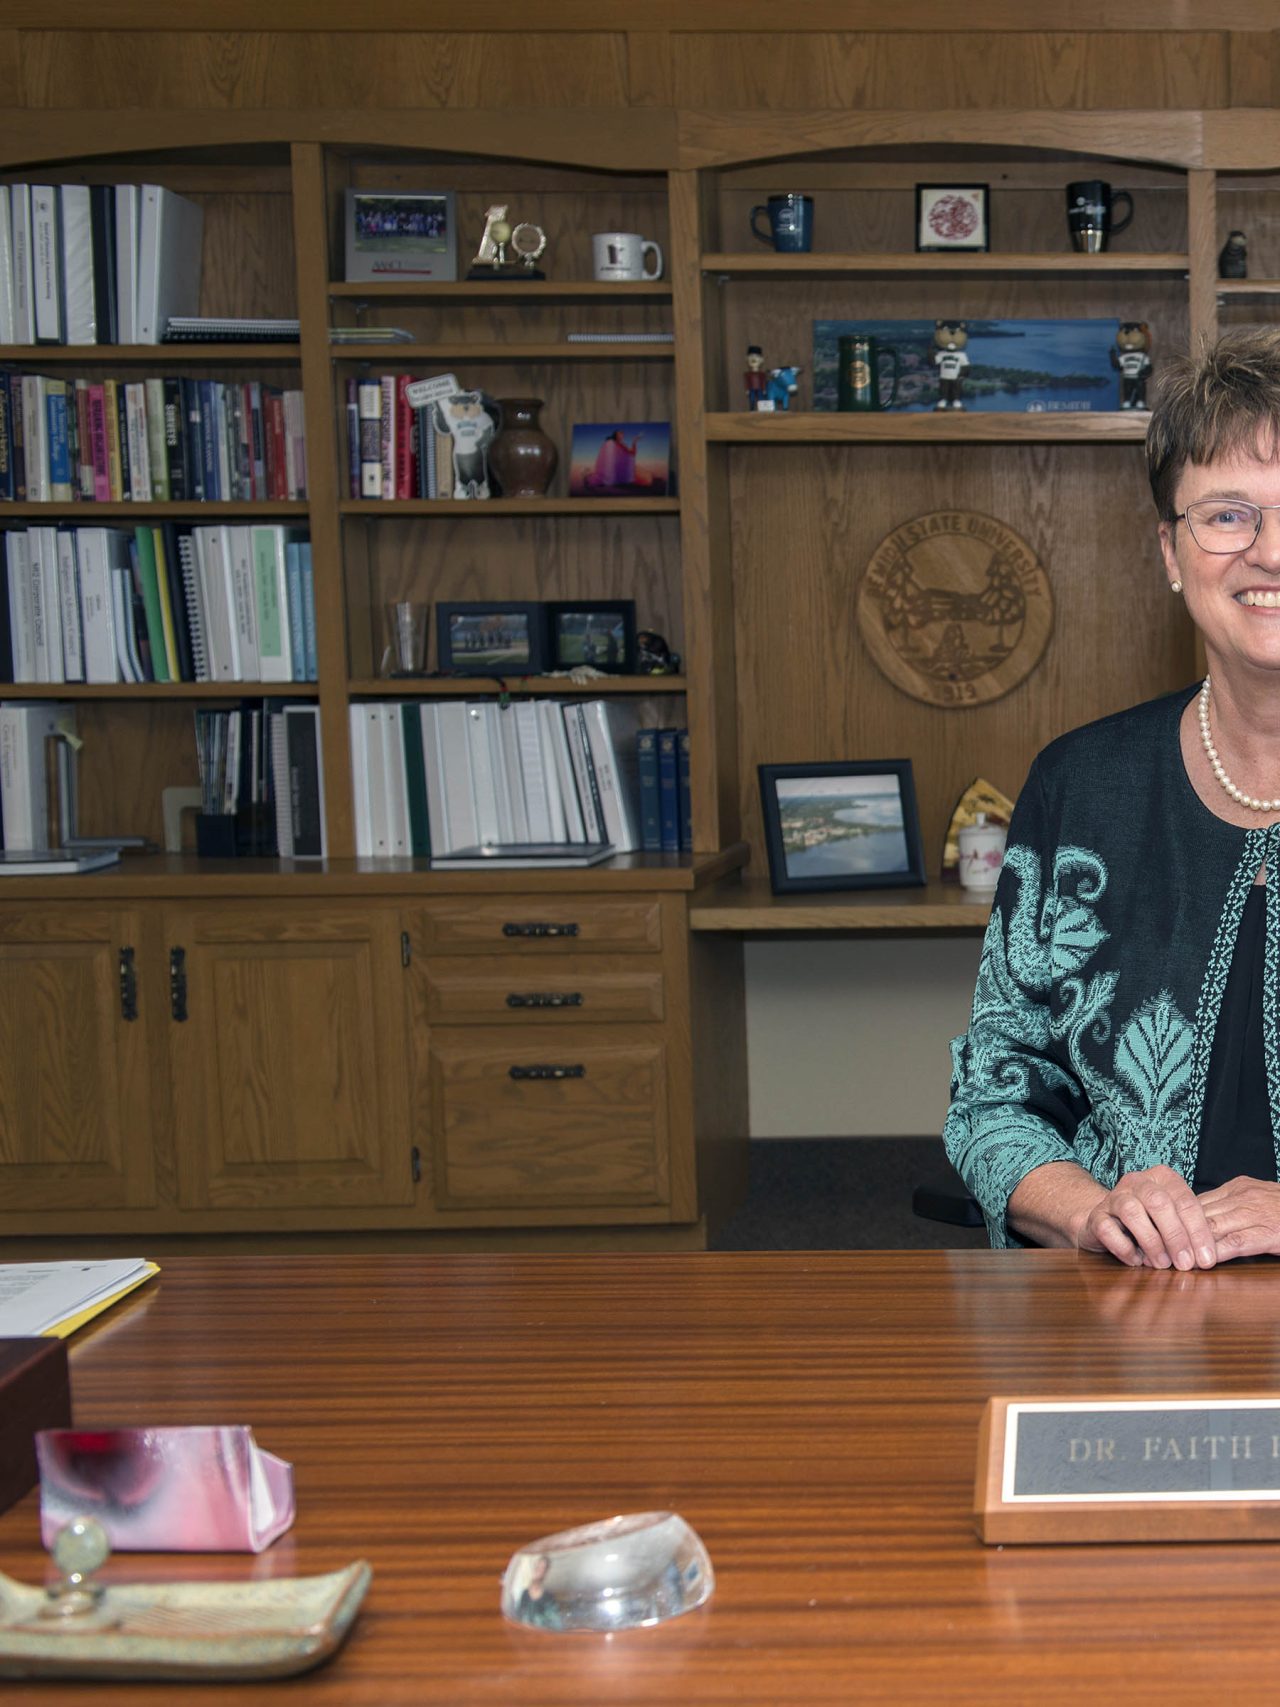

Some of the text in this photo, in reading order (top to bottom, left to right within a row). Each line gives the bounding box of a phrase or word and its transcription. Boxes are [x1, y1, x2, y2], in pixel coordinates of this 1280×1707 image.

[165, 404, 177, 446] SURVEYS
[906, 514, 962, 543] STATE
[968, 514, 1042, 598] UNIVERSITY
[1068, 1438, 1127, 1462] DR.
[1142, 1434, 1253, 1461] FAITH
